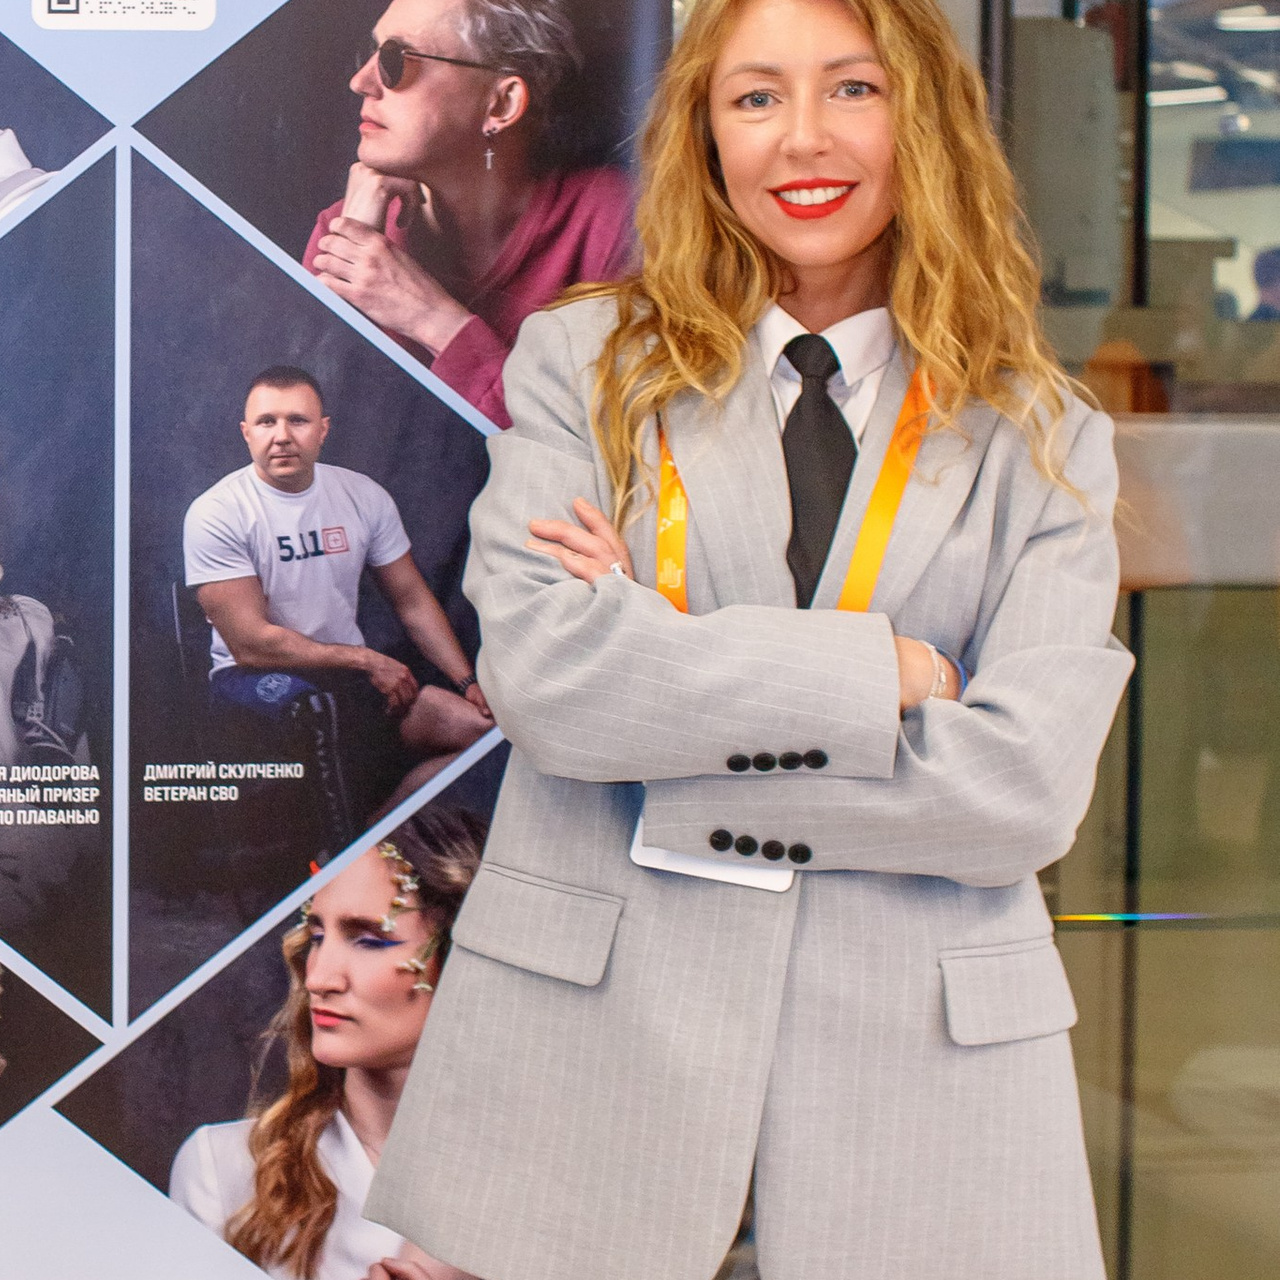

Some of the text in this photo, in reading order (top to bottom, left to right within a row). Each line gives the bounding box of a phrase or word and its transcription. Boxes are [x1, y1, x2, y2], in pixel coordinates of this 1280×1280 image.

[9, 765, 100, 783] ДИОДОРОВА
[144, 761, 304, 780] ДМИТРИЙ СКУПЧЕНКО
[42, 787, 100, 803] ПРИЗЕР
[144, 784, 238, 802] ВЕТЕРАН СВО
[16, 809, 100, 826] ПЛАВАНЬЮ
